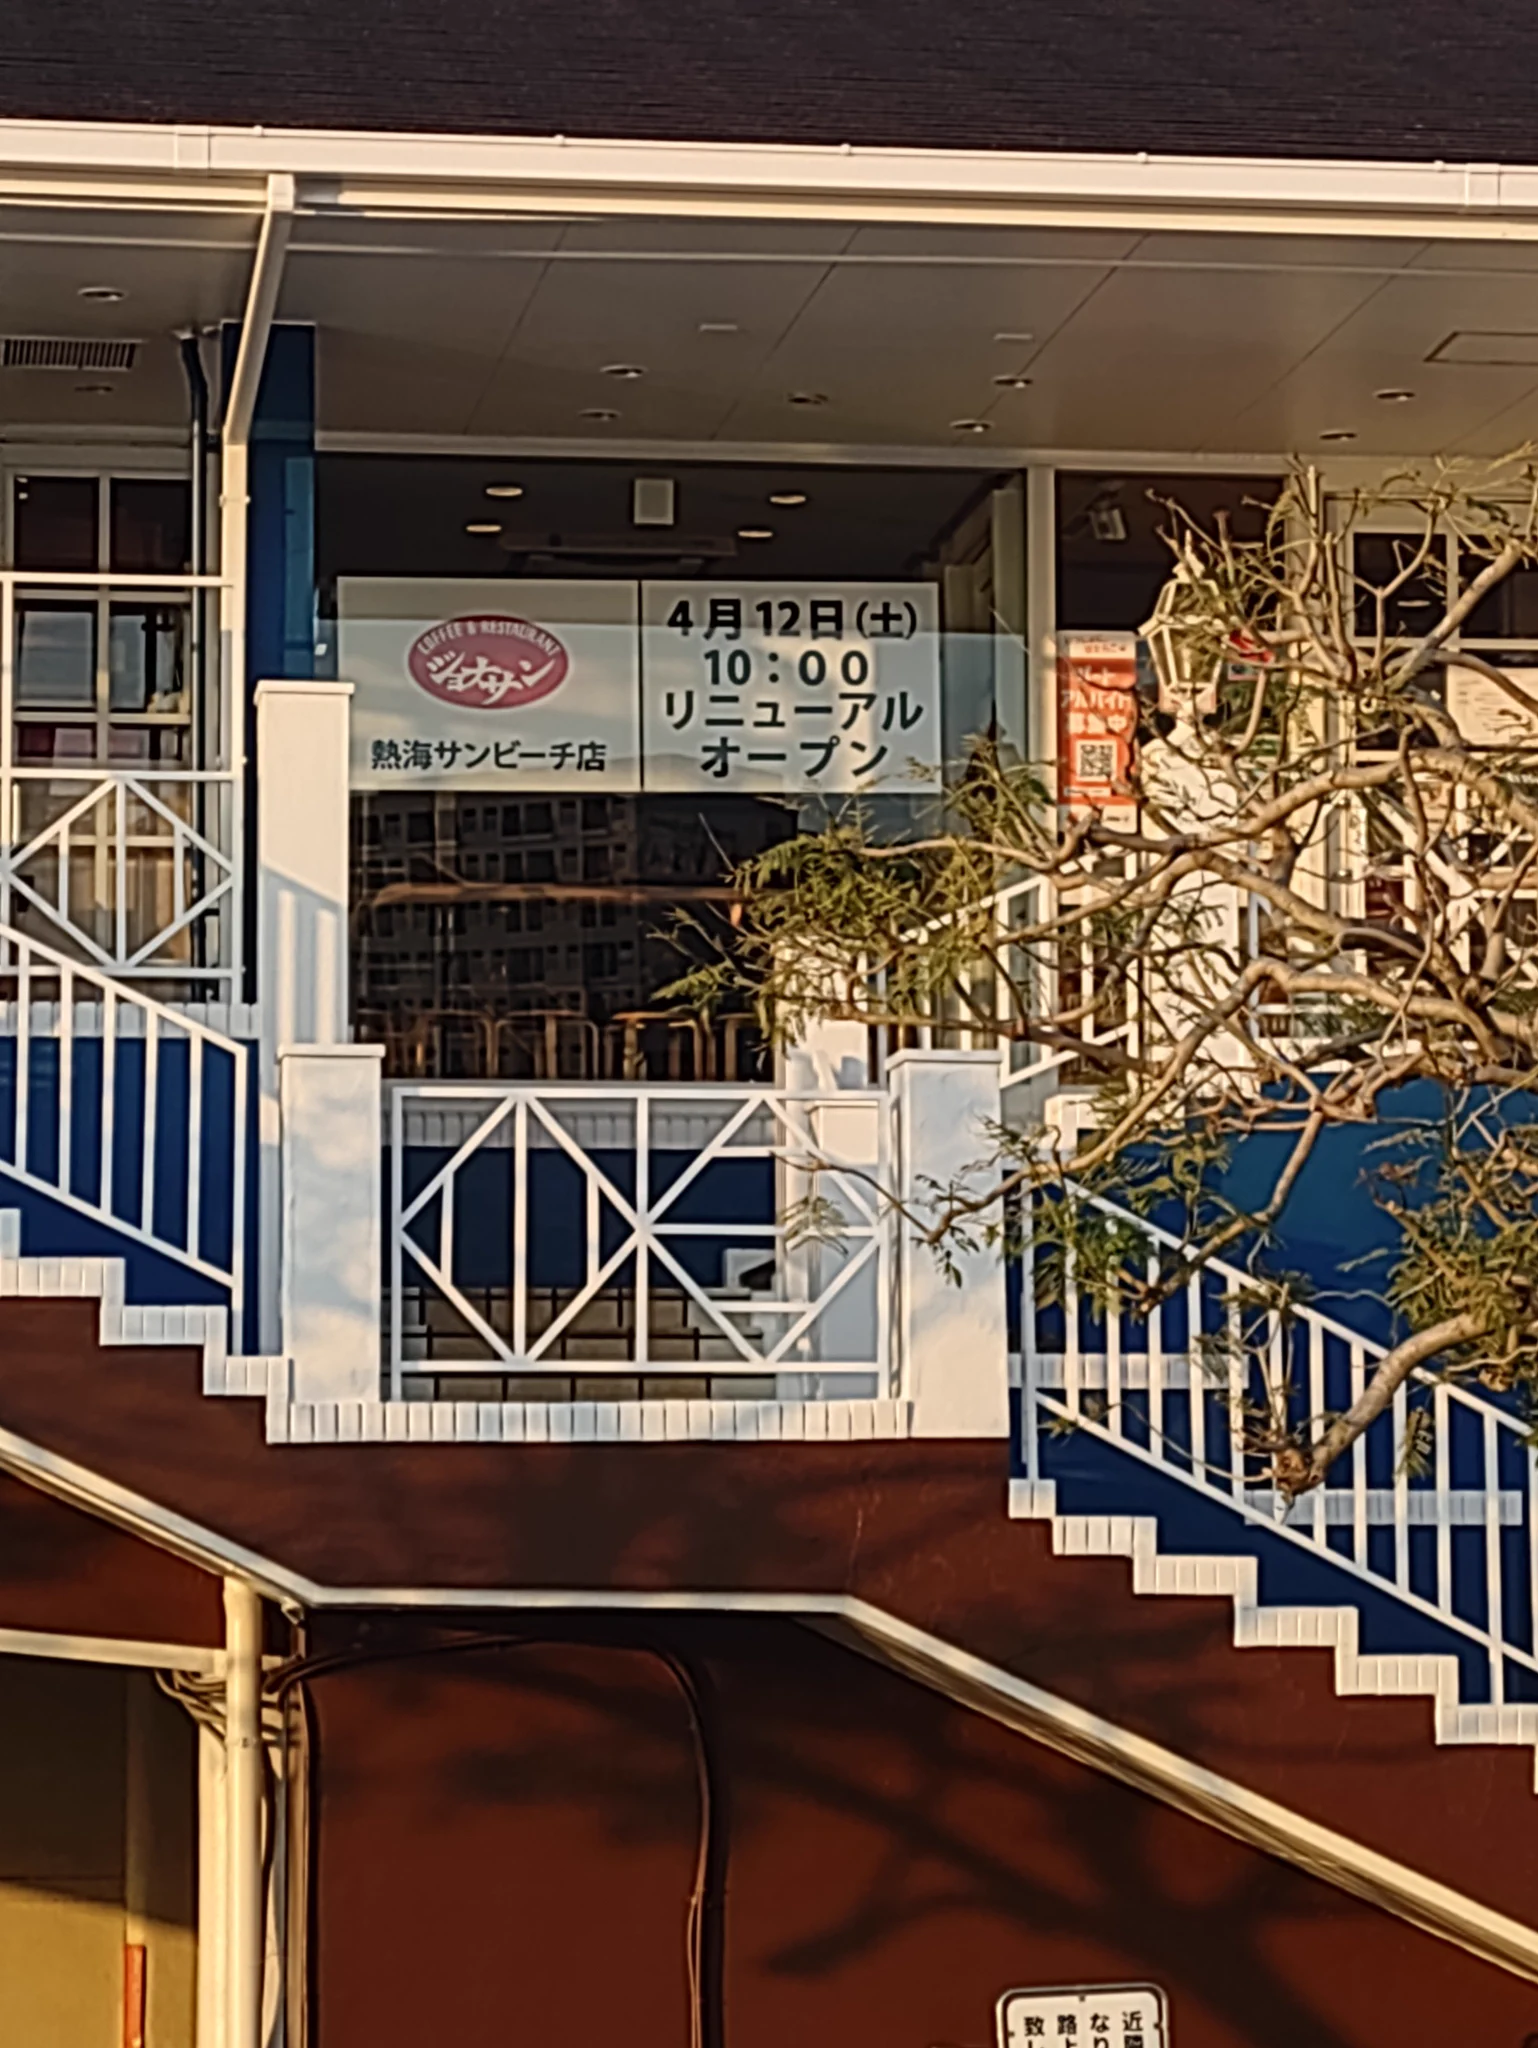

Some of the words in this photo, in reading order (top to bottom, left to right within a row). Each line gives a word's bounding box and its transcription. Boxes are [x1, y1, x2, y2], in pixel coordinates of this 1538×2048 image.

[417, 620, 463, 655] COFFEE
[480, 620, 561, 656] RESTAURANT
[666, 597, 919, 641] 4月12日(土)
[426, 650, 556, 706] ジョナサン
[664, 690, 925, 732] リニューアル
[371, 738, 607, 772] 熱海サンビーチ店
[699, 736, 890, 779] オープン
